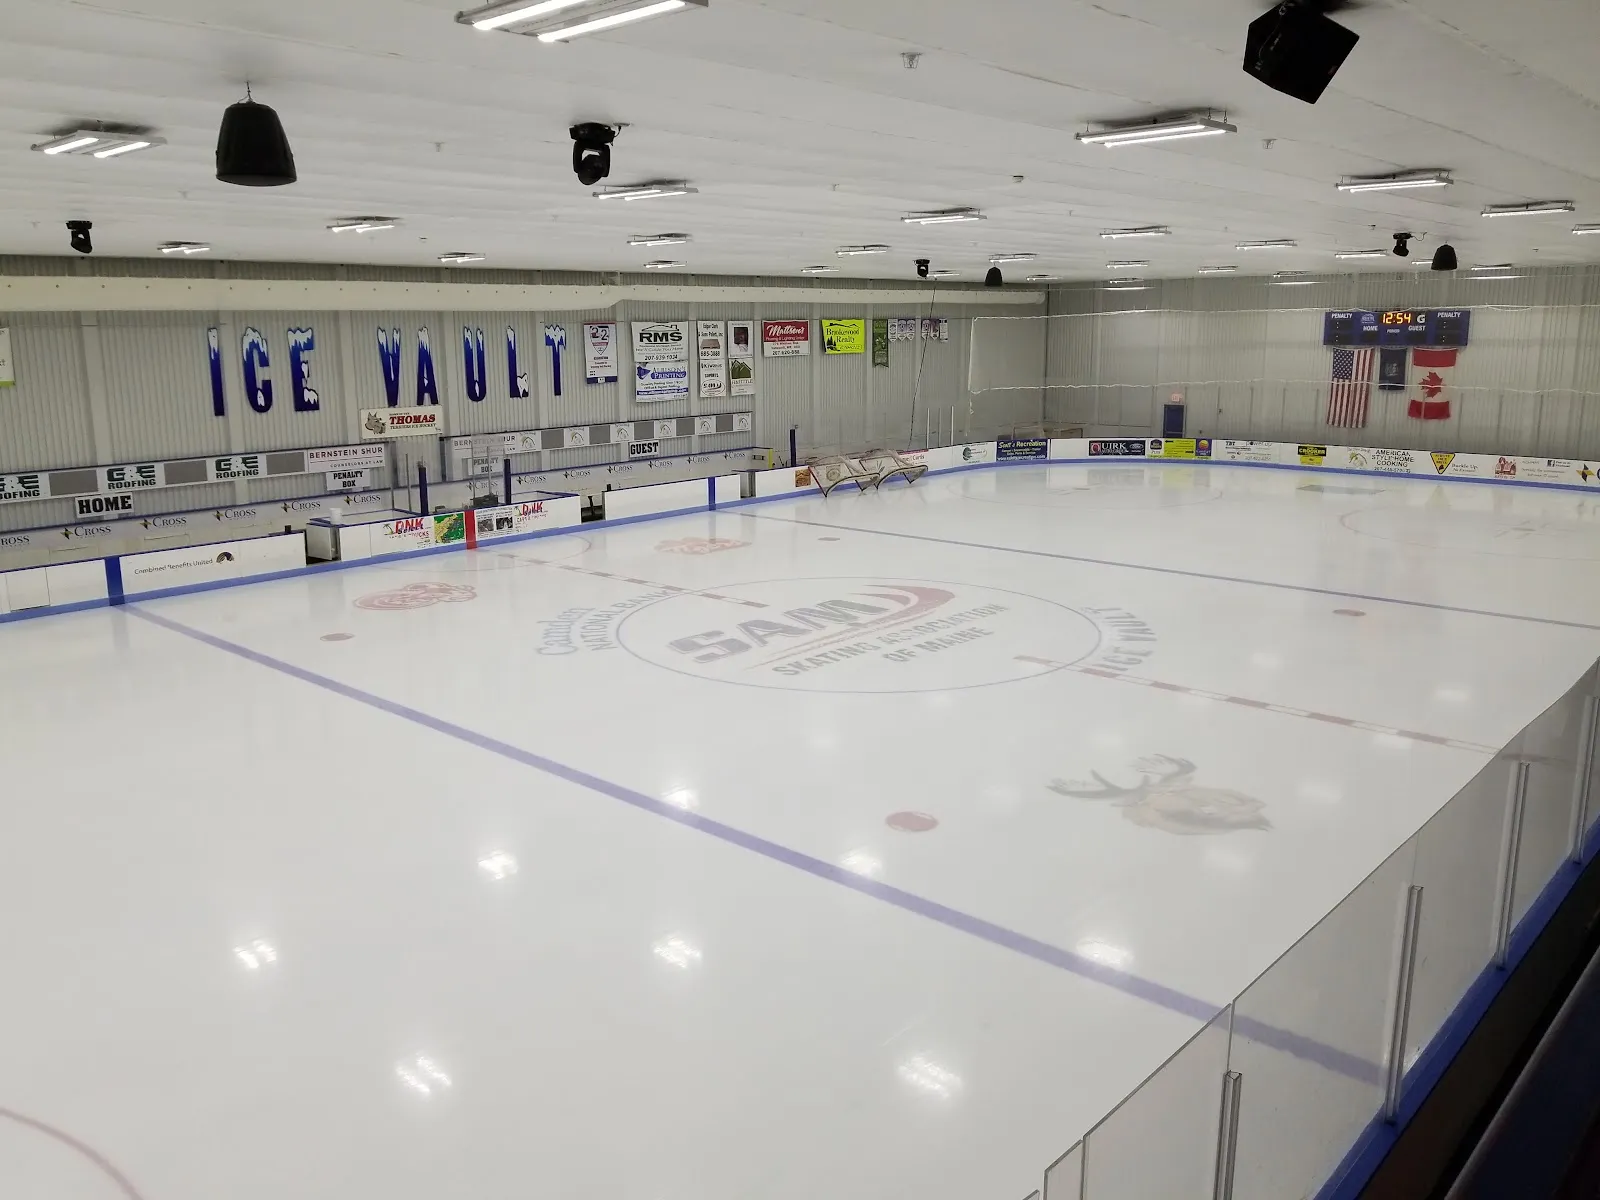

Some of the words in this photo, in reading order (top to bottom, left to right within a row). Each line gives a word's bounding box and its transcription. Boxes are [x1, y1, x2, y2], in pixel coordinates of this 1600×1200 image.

[1382, 312, 1411, 324] 12:54
[639, 332, 683, 342] RMS
[207, 327, 320, 417] ICE
[377, 324, 567, 408] VAULT
[389, 414, 436, 425] THOMAS
[309, 449, 359, 459] BERNSTEIN
[361, 446, 383, 454] SHUR
[630, 442, 659, 455] GUEST
[215, 456, 259, 471] G&E
[473, 457, 499, 466] PENATY
[107, 465, 156, 482] G&E
[216, 469, 259, 479] ROOFING
[333, 471, 364, 480] PENALTY
[108, 478, 156, 490] ROOFING
[342, 480, 356, 488] BOX
[0, 489, 40, 500] OFING
[78, 495, 132, 514] HOME
[0, 535, 30, 546] ROSS
[579, 609, 627, 651] NATIONAL
[667, 598, 890, 664] SAM
[771, 641, 879, 676] SKATING
[879, 603, 1008, 645] ASSOCIATION
[882, 647, 917, 663] OF
[920, 626, 995, 653] MAINE
